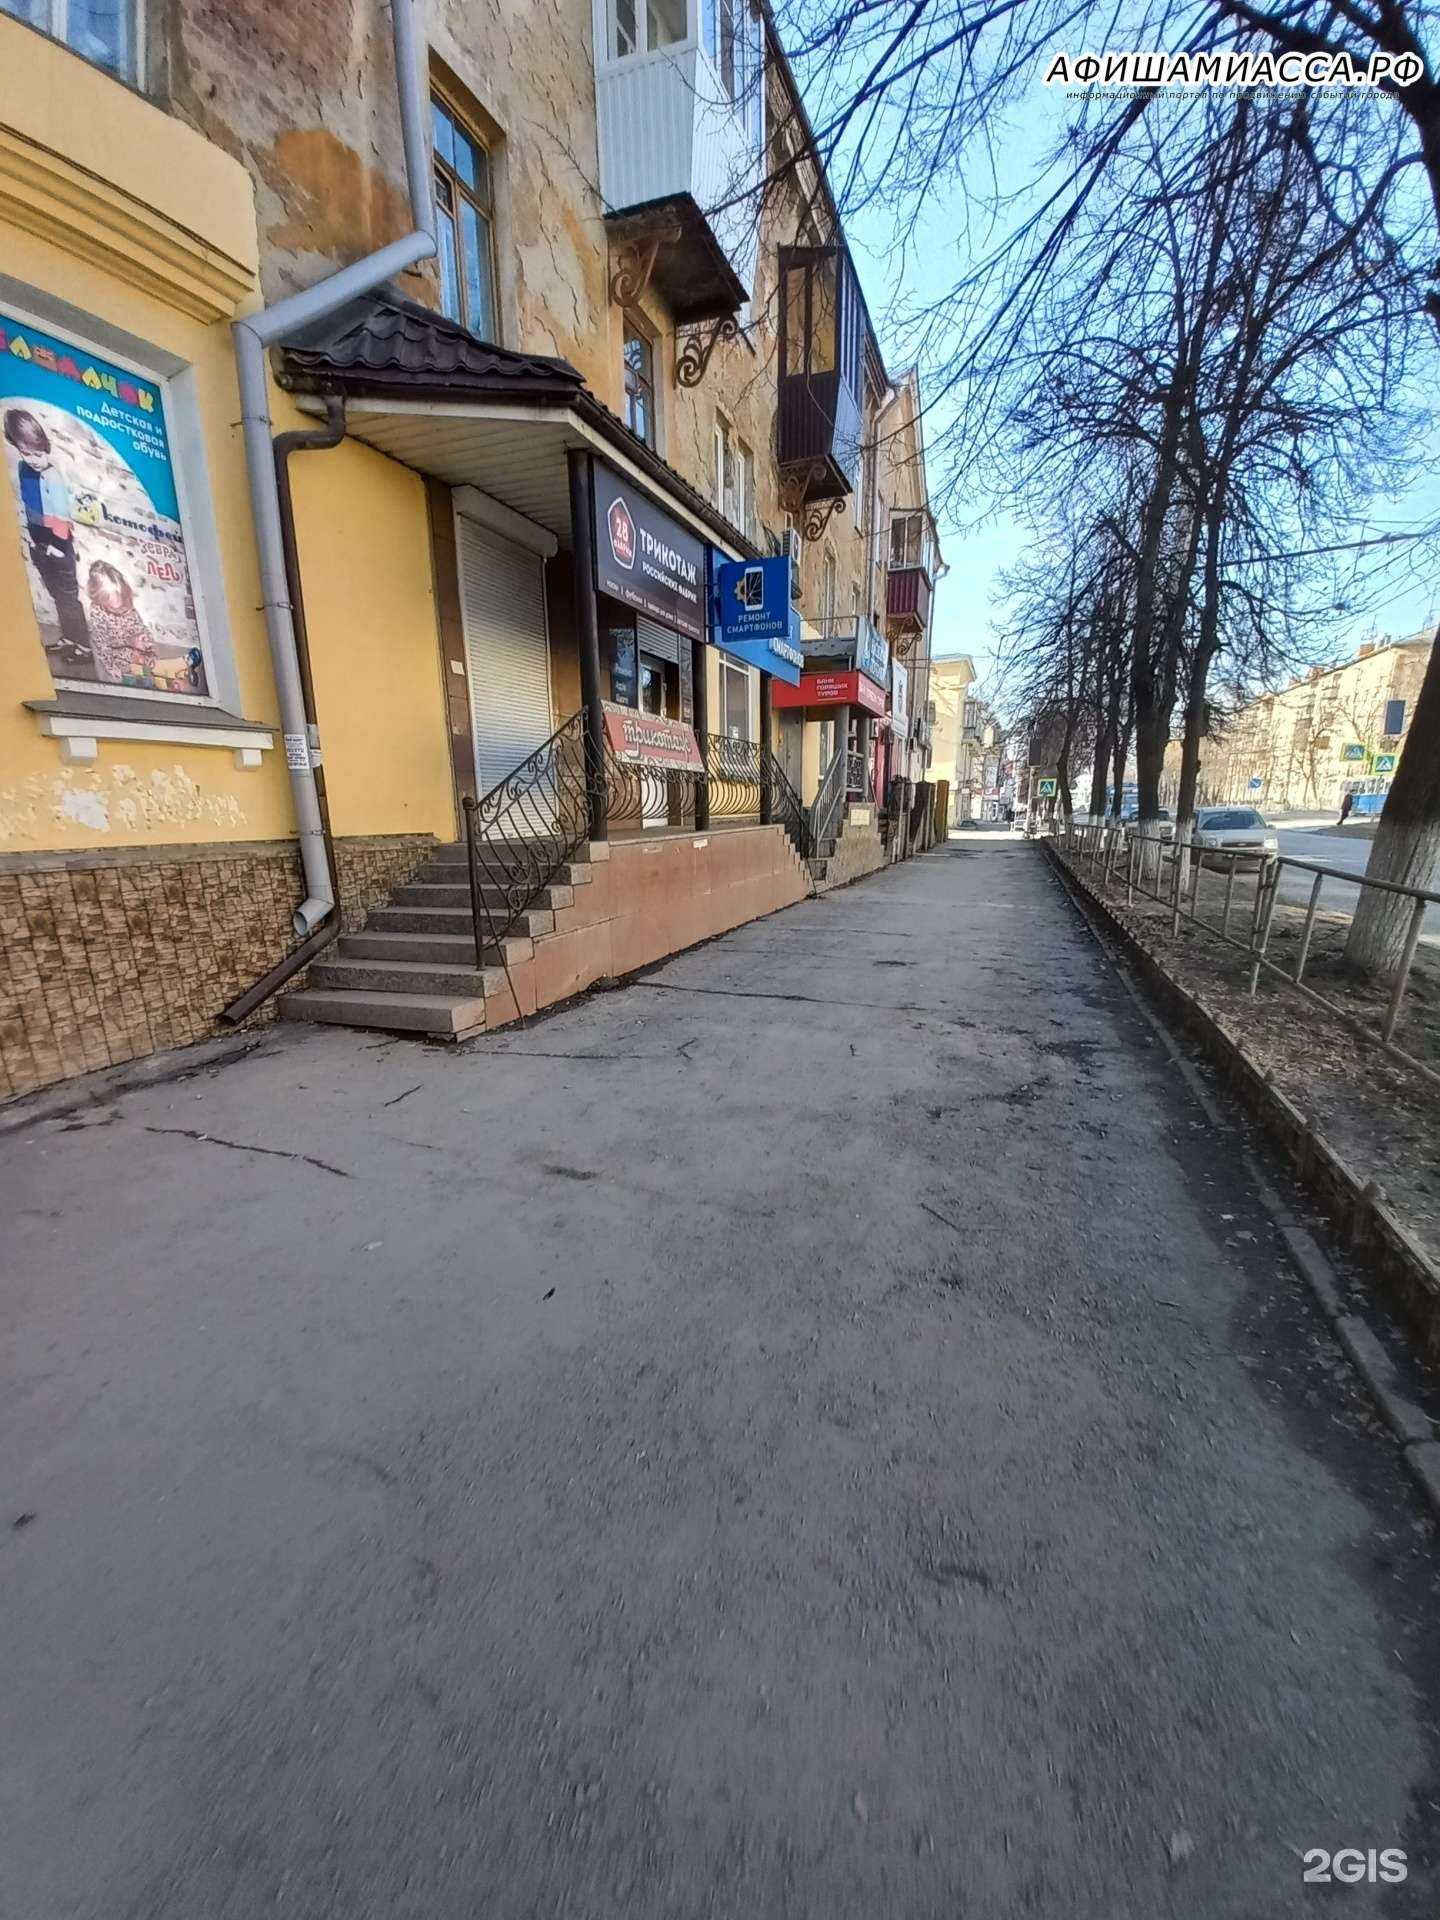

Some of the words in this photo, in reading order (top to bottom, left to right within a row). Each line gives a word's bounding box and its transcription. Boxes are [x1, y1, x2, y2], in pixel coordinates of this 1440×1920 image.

[76, 405, 165, 449] подростковая
[101, 401, 153, 433] Детская
[132, 440, 167, 461] обувь
[615, 518, 629, 542] 28
[639, 527, 697, 586] ТРИКОТАЖ
[642, 561, 679, 592] РОССИЙСКИХ
[679, 584, 698, 604] ФАБРИК
[726, 620, 783, 634] СМАРТФОНОВ
[738, 611, 771, 624] РЕМОНТ
